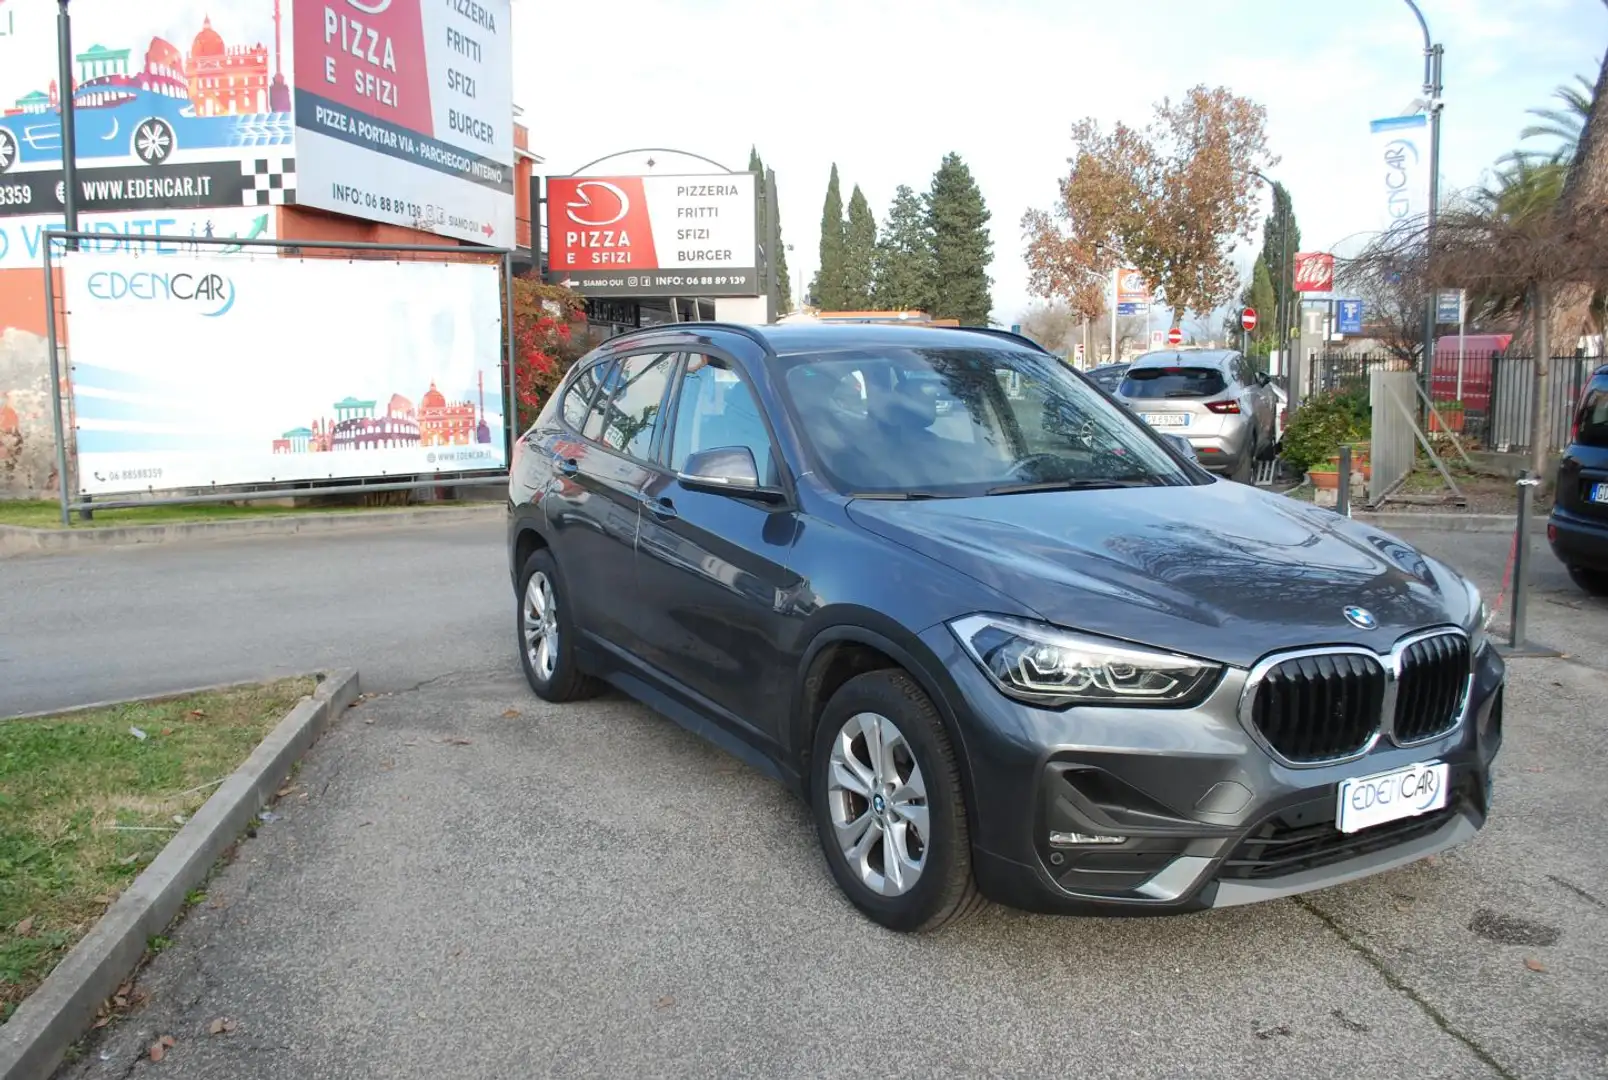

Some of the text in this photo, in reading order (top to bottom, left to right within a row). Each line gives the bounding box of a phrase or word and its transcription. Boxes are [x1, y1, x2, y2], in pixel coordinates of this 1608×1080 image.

[446, 0, 497, 35] IZZERIA
[324, 5, 397, 74] PIZZA
[446, 26, 481, 64] FRITTI
[325, 55, 398, 108] E SFIZI
[447, 67, 476, 99] SFIZI
[448, 108, 494, 145] BURGER
[315, 105, 503, 184] PIZZE A PORTAR VIA PARCHEGGIO INTERNO
[82, 176, 211, 200] WWW.EDENCAR.IT
[332, 182, 363, 206] INFO:
[365, 192, 377, 209] 06
[380, 196, 391, 212] 88
[394, 199, 405, 215] 89
[407, 202, 421, 218] 139
[677, 185, 739, 197] PIZZERIA
[677, 206, 719, 218] FRITTI
[566, 230, 631, 248] PIZZA
[677, 228, 710, 240] SFIZI
[567, 251, 631, 264] E SFIZI
[677, 249, 732, 261] BURGER
[88, 271, 225, 300] EDENCAR
[583, 275, 746, 287] SIAMO QUI INFO: 06 88 89 139
[1352, 769, 1434, 811] EDENCAR
